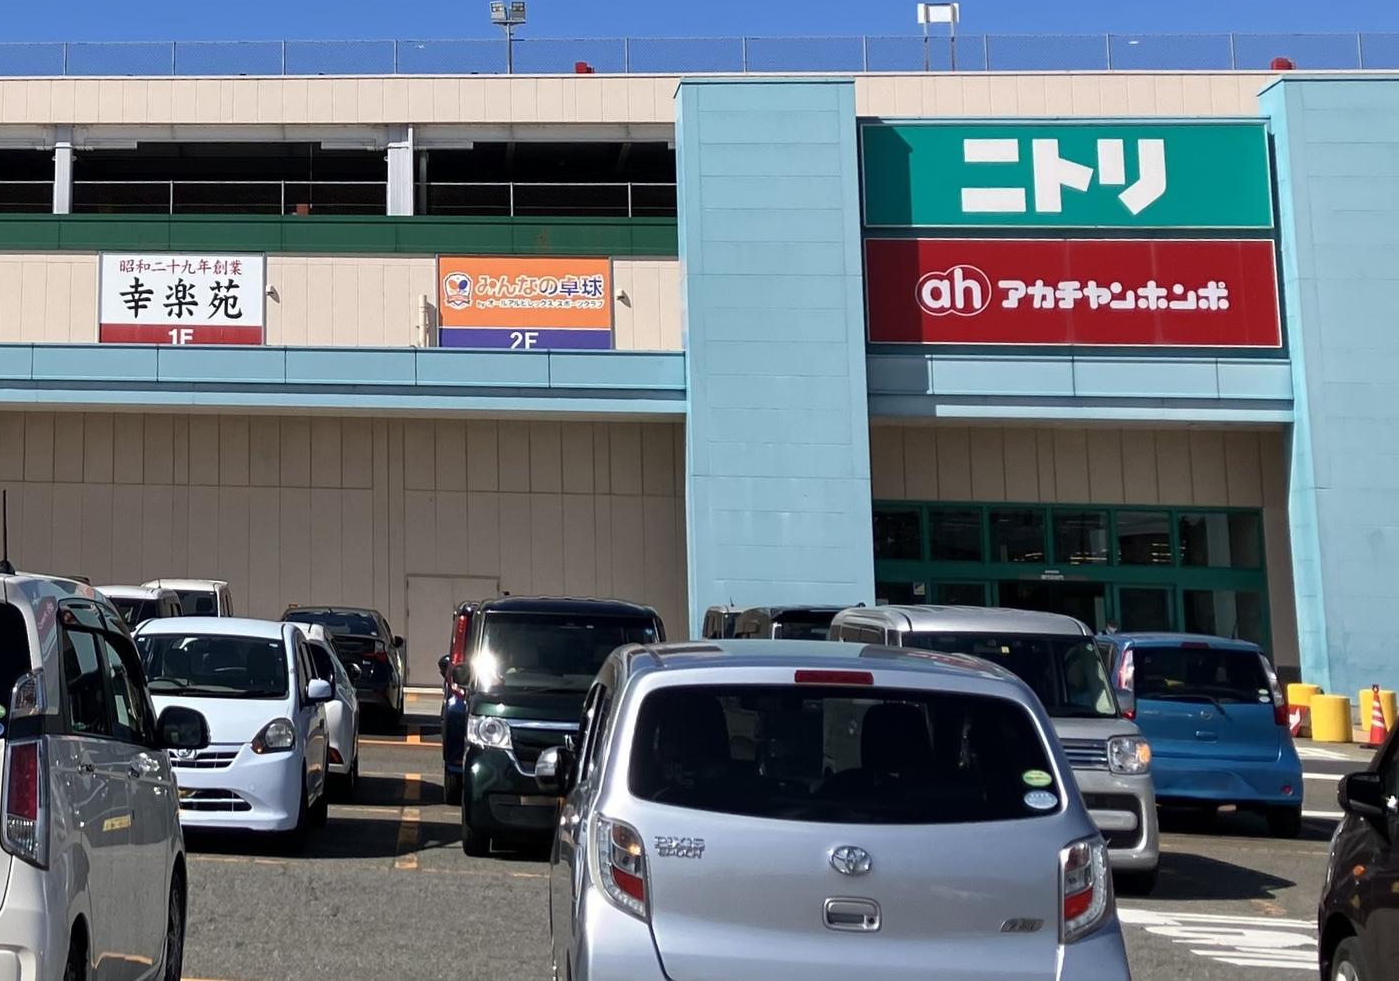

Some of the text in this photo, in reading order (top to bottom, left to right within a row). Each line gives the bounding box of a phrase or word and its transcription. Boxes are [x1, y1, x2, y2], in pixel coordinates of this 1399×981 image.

[961, 138, 1167, 216] ニトリ
[119, 259, 242, 276] 昭和二十九年創業
[474, 274, 603, 297] みんなの卓球
[922, 268, 1230, 311] ah アカチャンホンポ
[119, 277, 243, 319] 幸楽苑
[169, 329, 193, 344] 1F
[510, 332, 539, 349] 2F
